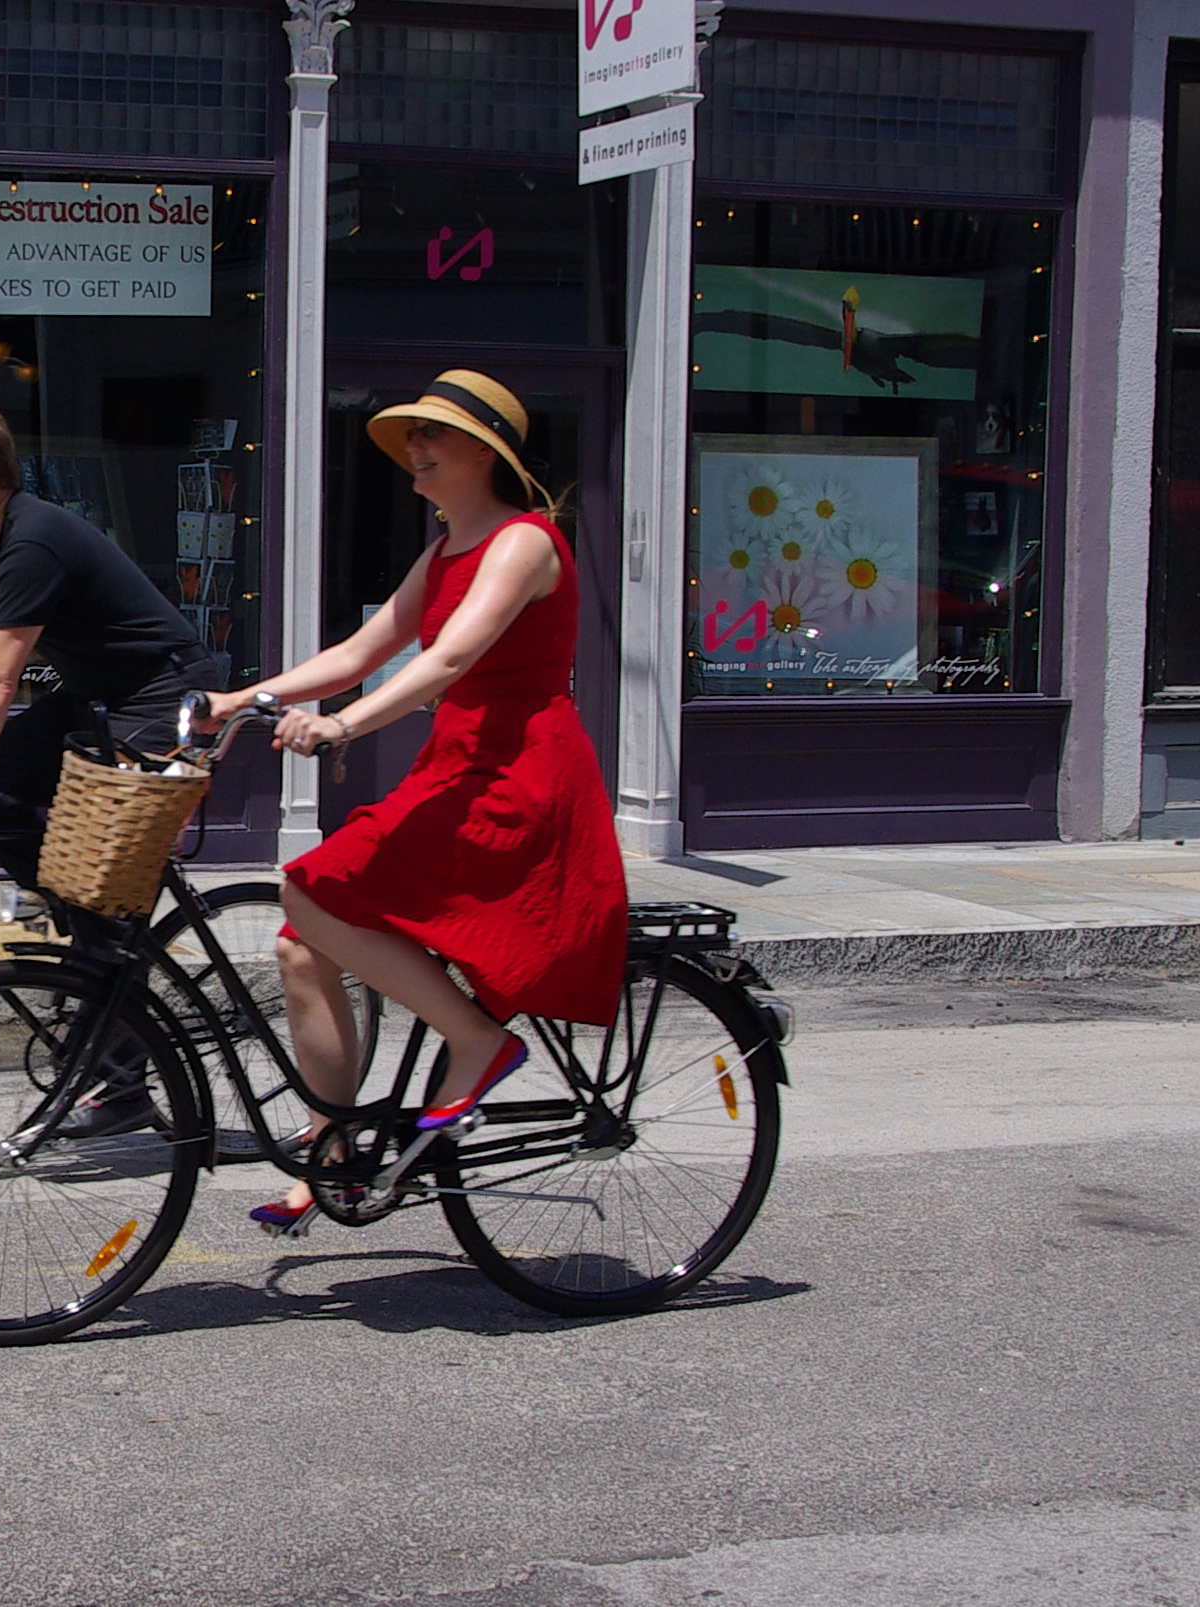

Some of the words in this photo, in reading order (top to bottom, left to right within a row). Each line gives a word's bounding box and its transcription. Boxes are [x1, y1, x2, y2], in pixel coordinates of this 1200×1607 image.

[584, 44, 683, 84] imagingartsgallery
[583, 148, 590, 165] &
[637, 127, 686, 156] printing
[149, 194, 209, 225] Sale
[6, 243, 131, 262] ADVANTAGE
[142, 244, 170, 262] OF
[180, 245, 205, 263] US
[43, 279, 71, 297] TO
[81, 280, 120, 298] GET
[131, 281, 177, 298] PAID
[813, 651, 838, 674] The
